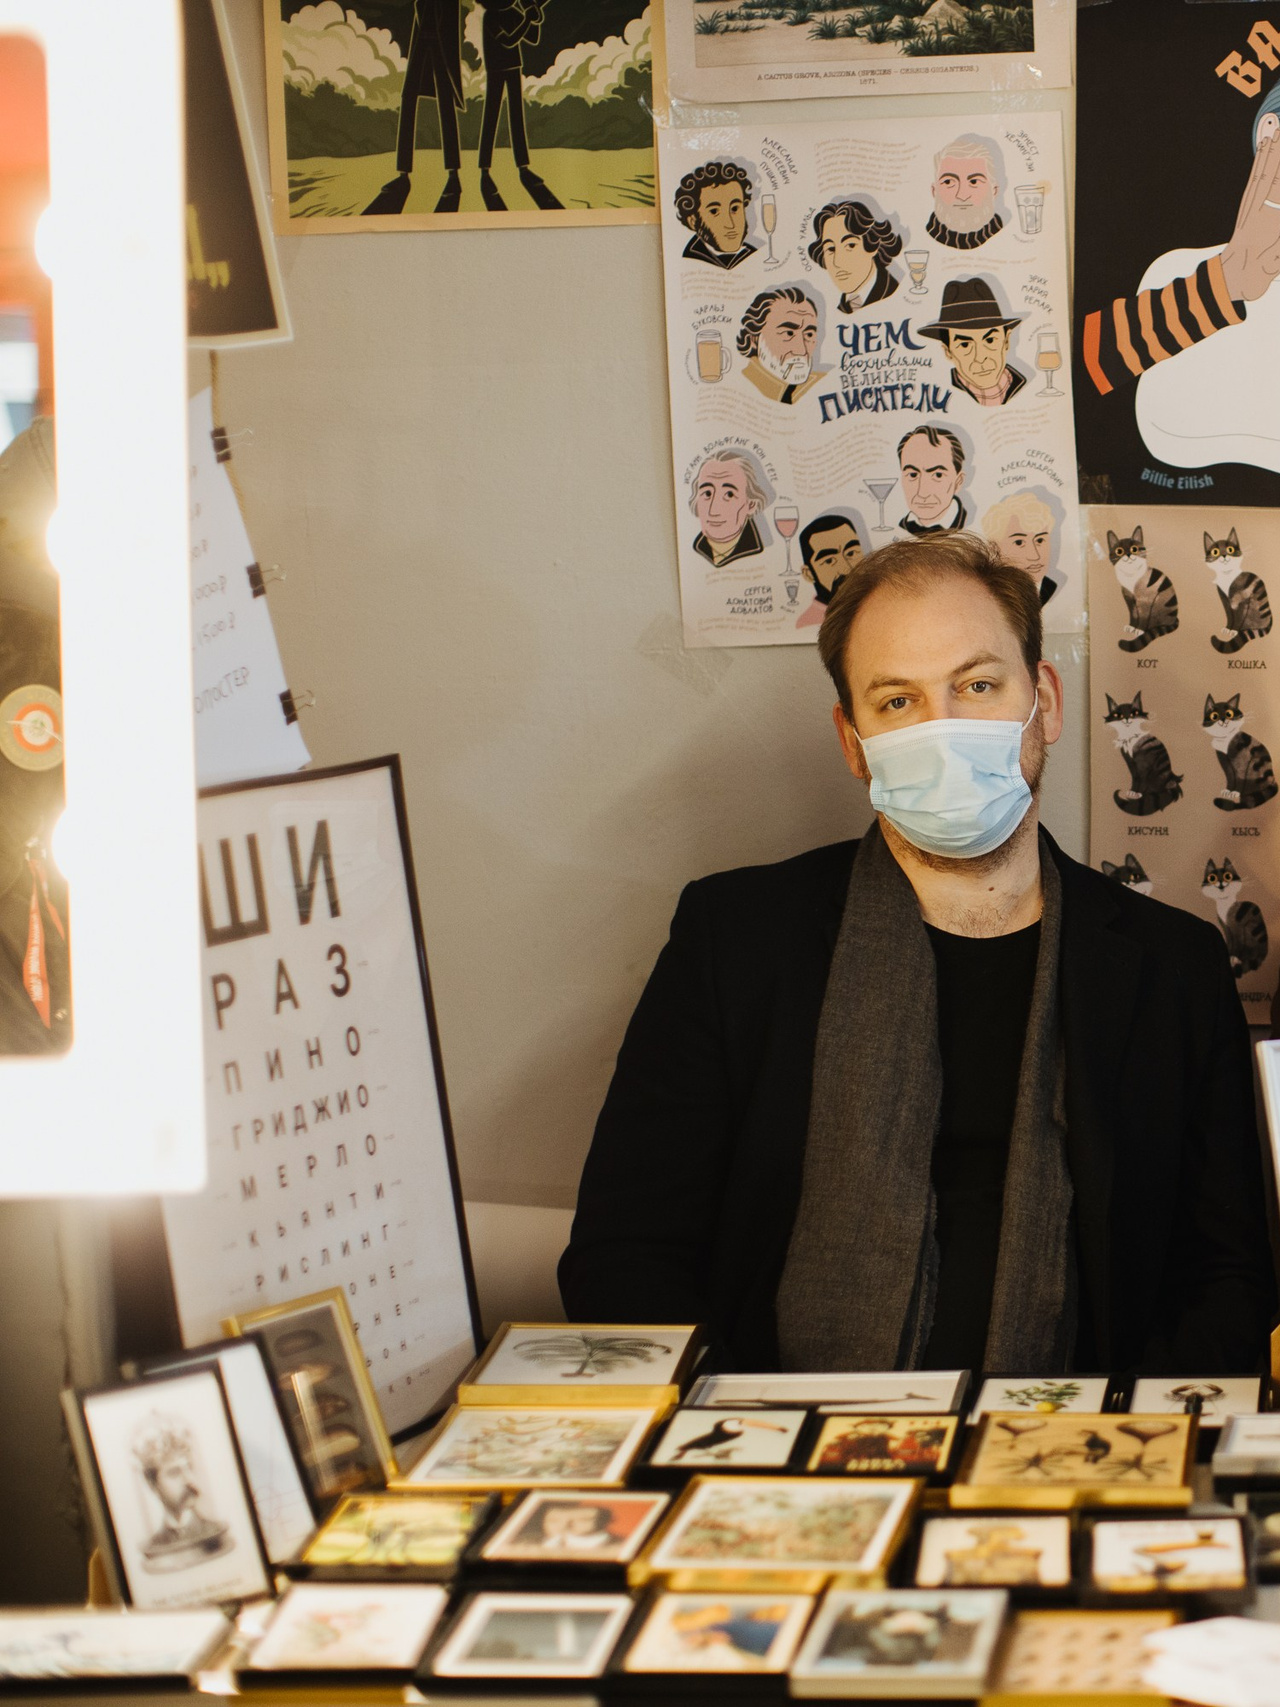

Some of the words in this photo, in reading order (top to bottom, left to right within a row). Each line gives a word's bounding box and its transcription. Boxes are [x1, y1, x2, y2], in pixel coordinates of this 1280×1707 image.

[764, 72, 793, 80] CACTUS
[823, 70, 857, 78] ARIZONA
[762, 136, 798, 175] АЛЕКСАНДР
[759, 161, 779, 191] ПУШКИН
[761, 148, 791, 185] СЕРГЕЕВИЧ
[797, 245, 812, 272] ОСКАР
[1029, 274, 1049, 286] ЭРИХ
[1021, 285, 1049, 299] МАРИЯ
[1024, 295, 1054, 315] РЕМАРК
[836, 317, 927, 358] ЧЕМ
[840, 368, 918, 389] ВЕЛИКИЕ
[818, 383, 952, 424] ПИСАТЕЛИ
[752, 443, 766, 460] ФОН
[997, 475, 1027, 488] ЕСЕНИН
[1141, 468, 1175, 488] Billie
[1177, 474, 1214, 490] Eilish
[730, 604, 774, 615] ДОВЛАТОВ
[1136, 658, 1159, 670] КОТ
[1227, 659, 1267, 670] КОШКА
[1127, 825, 1170, 837] КИСУНЯ
[1231, 826, 1261, 838] КЫСЬ
[231, 1083, 370, 1151] ГРИДЖИО
[240, 1133, 378, 1201] МЕРЛО
